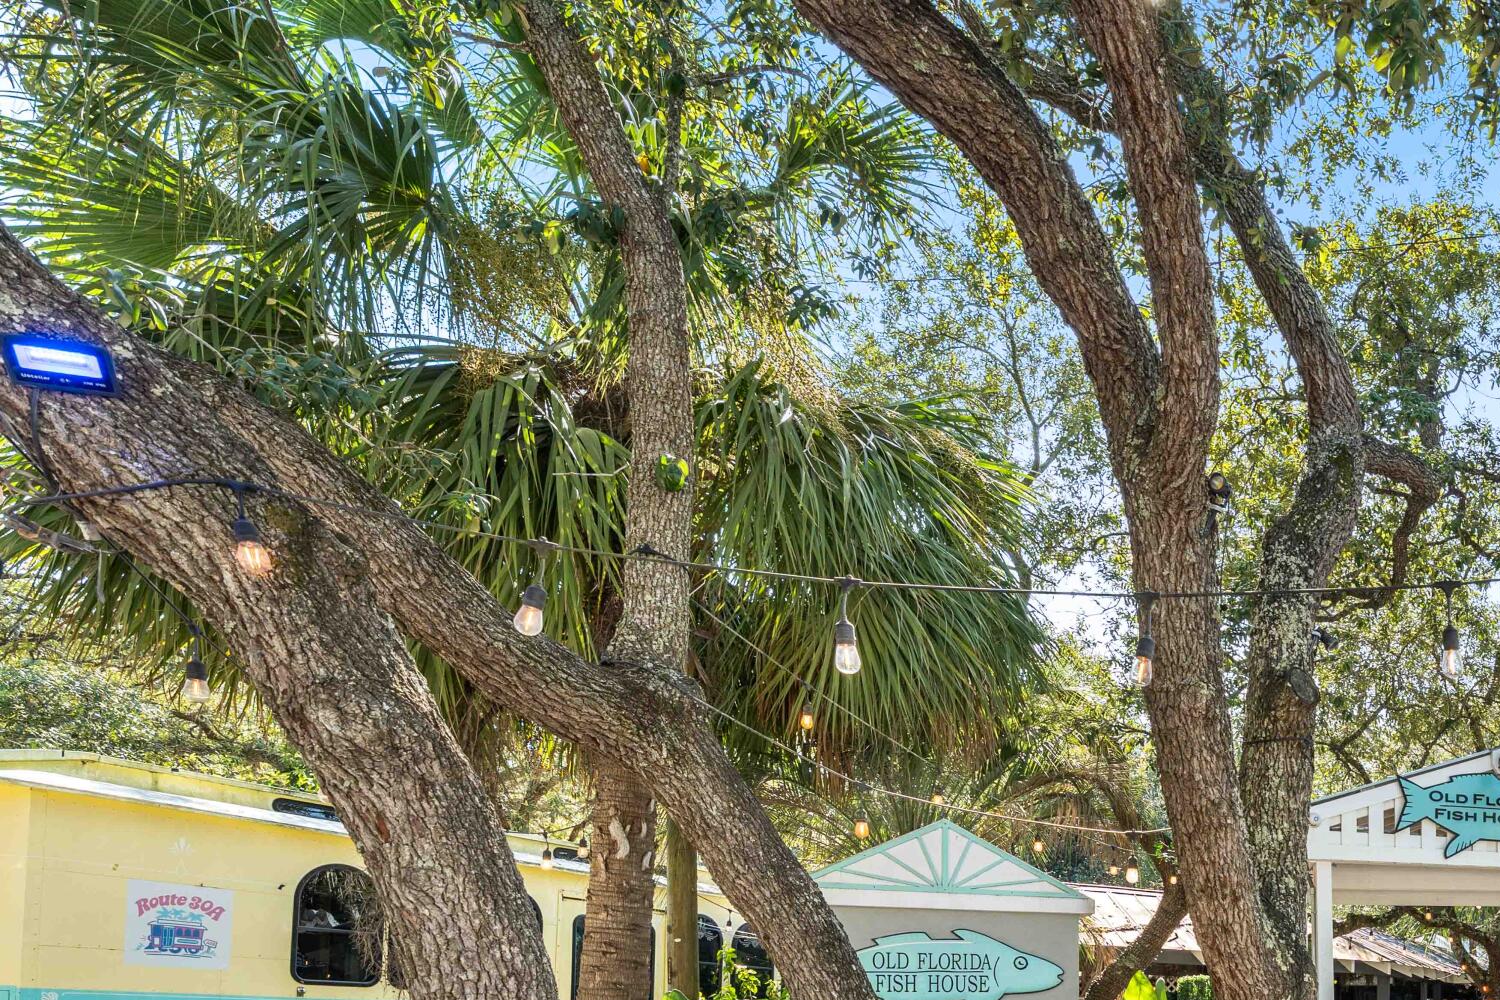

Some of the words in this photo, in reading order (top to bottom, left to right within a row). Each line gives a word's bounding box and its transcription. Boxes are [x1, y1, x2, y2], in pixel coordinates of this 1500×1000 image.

[1429, 790, 1471, 804] OLD
[1434, 808, 1477, 822] FISH
[135, 894, 188, 917] Route
[189, 896, 226, 921] 30A
[872, 952, 909, 970] OLD
[917, 953, 992, 971] FLORIDA
[875, 974, 918, 993] FISH
[928, 974, 990, 993] HOUSE
